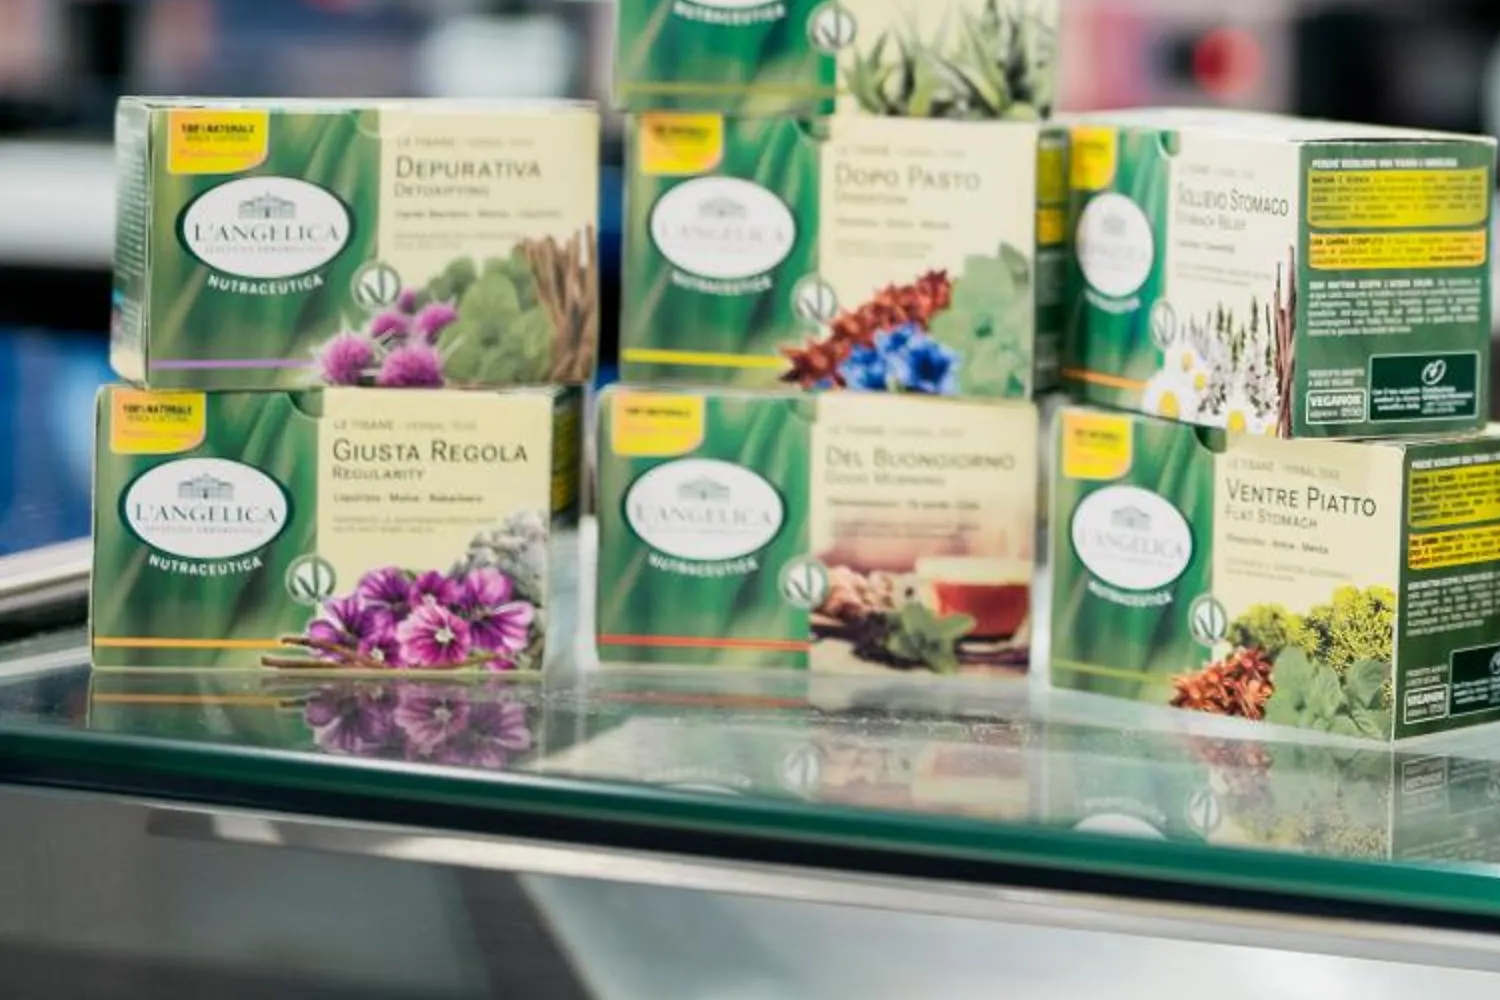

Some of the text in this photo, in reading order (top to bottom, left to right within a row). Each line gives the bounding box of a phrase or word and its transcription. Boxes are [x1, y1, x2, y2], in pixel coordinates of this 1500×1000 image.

[1230, 188, 1289, 217] STOMACO
[194, 222, 341, 242] L'ANGELICA
[207, 273, 325, 296] NUTRACEUTICA
[332, 437, 529, 463] GIUSTA REGOLA
[332, 466, 425, 481] REGULARITY
[1225, 476, 1377, 518] VENTRE PIATTO
[134, 503, 279, 523] L'ANGELICA
[1224, 503, 1318, 530] FLAT STOMACH
[148, 553, 264, 577] NUTRACEUTICA
